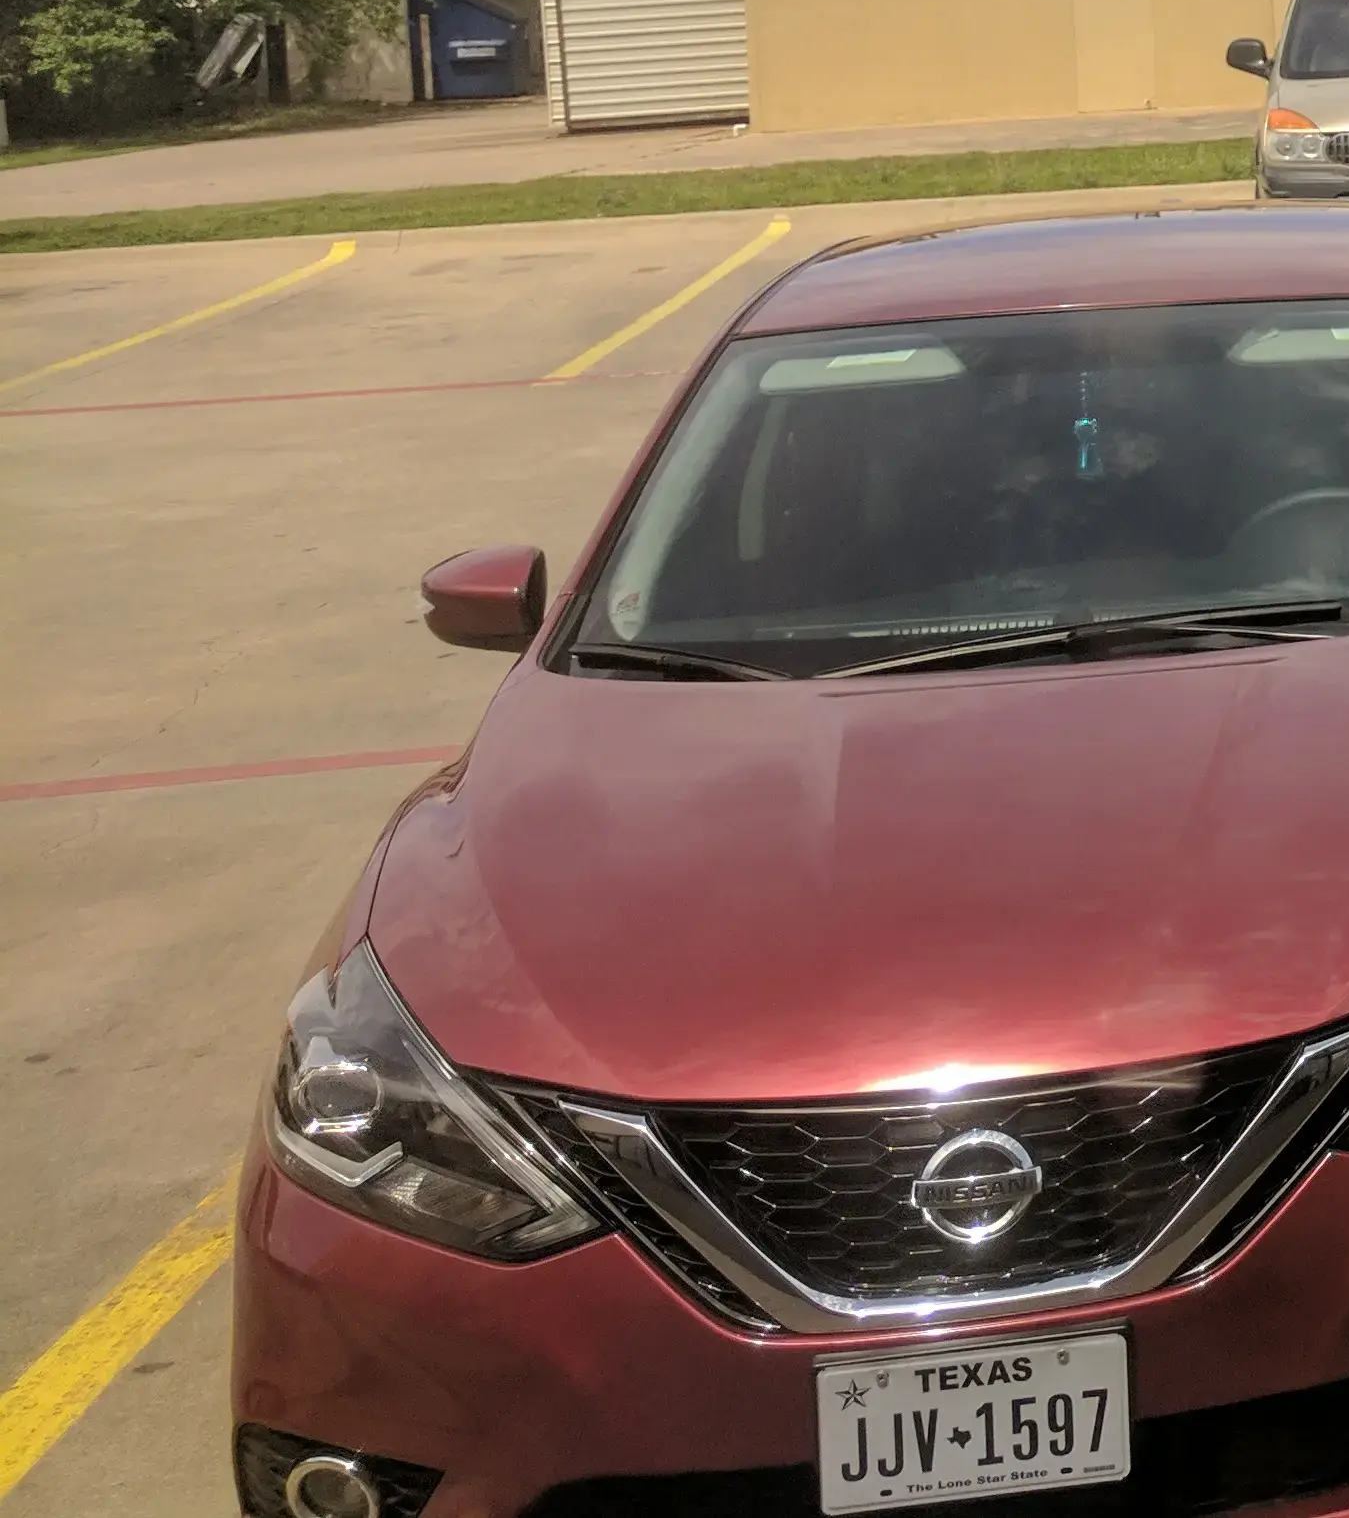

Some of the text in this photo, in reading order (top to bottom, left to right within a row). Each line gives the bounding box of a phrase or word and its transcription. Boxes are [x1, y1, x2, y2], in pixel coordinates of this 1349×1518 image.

[924, 1174, 1028, 1204] NISSAN
[914, 1357, 1033, 1393] TEXAS
[906, 1468, 1048, 1494] The Lone Star State
